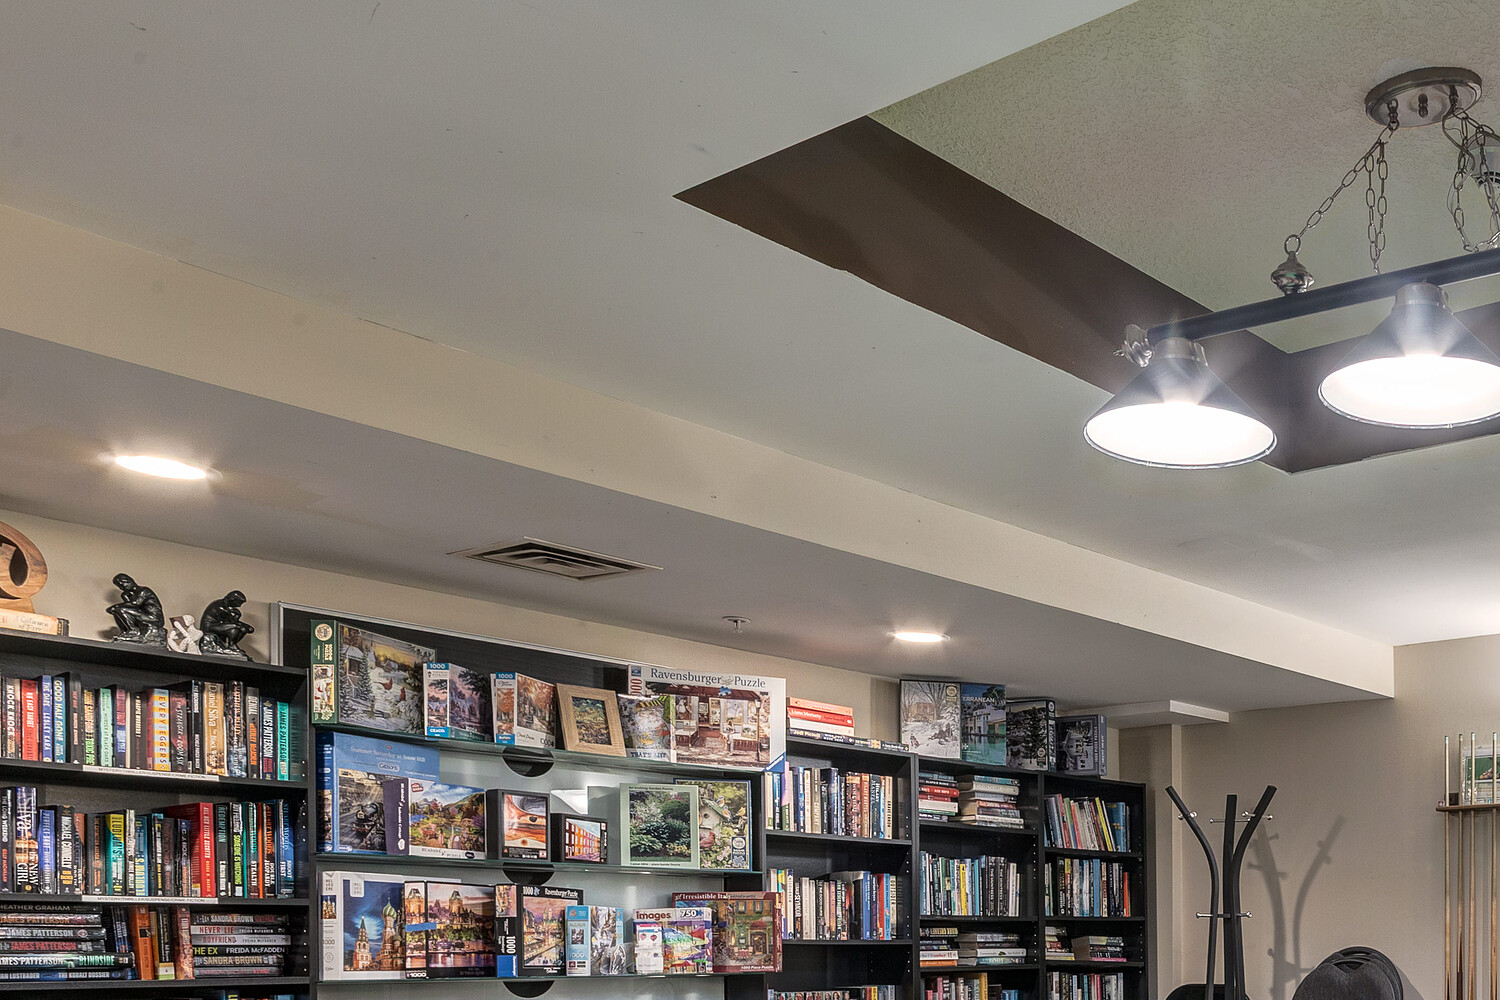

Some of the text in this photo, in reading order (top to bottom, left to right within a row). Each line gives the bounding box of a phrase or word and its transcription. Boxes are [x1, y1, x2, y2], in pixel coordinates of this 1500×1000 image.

[651, 668, 766, 688] Ravensburger Puzzle
[55, 704, 63, 719] HALF
[208, 685, 218, 726] Daniel Silva
[248, 696, 257, 715] DENIAL
[263, 707, 273, 726] JAMES
[159, 731, 167, 763] EGGERS
[264, 727, 273, 757] PATTERSON
[62, 816, 71, 840] MICHAEL
[62, 841, 72, 869] CONNELLY
[17, 863, 28, 885] GIRL
[636, 911, 672, 920] images
[7, 929, 31, 937] JAMES
[36, 942, 77, 950] PATTERSON
[507, 936, 516, 954] 1000
